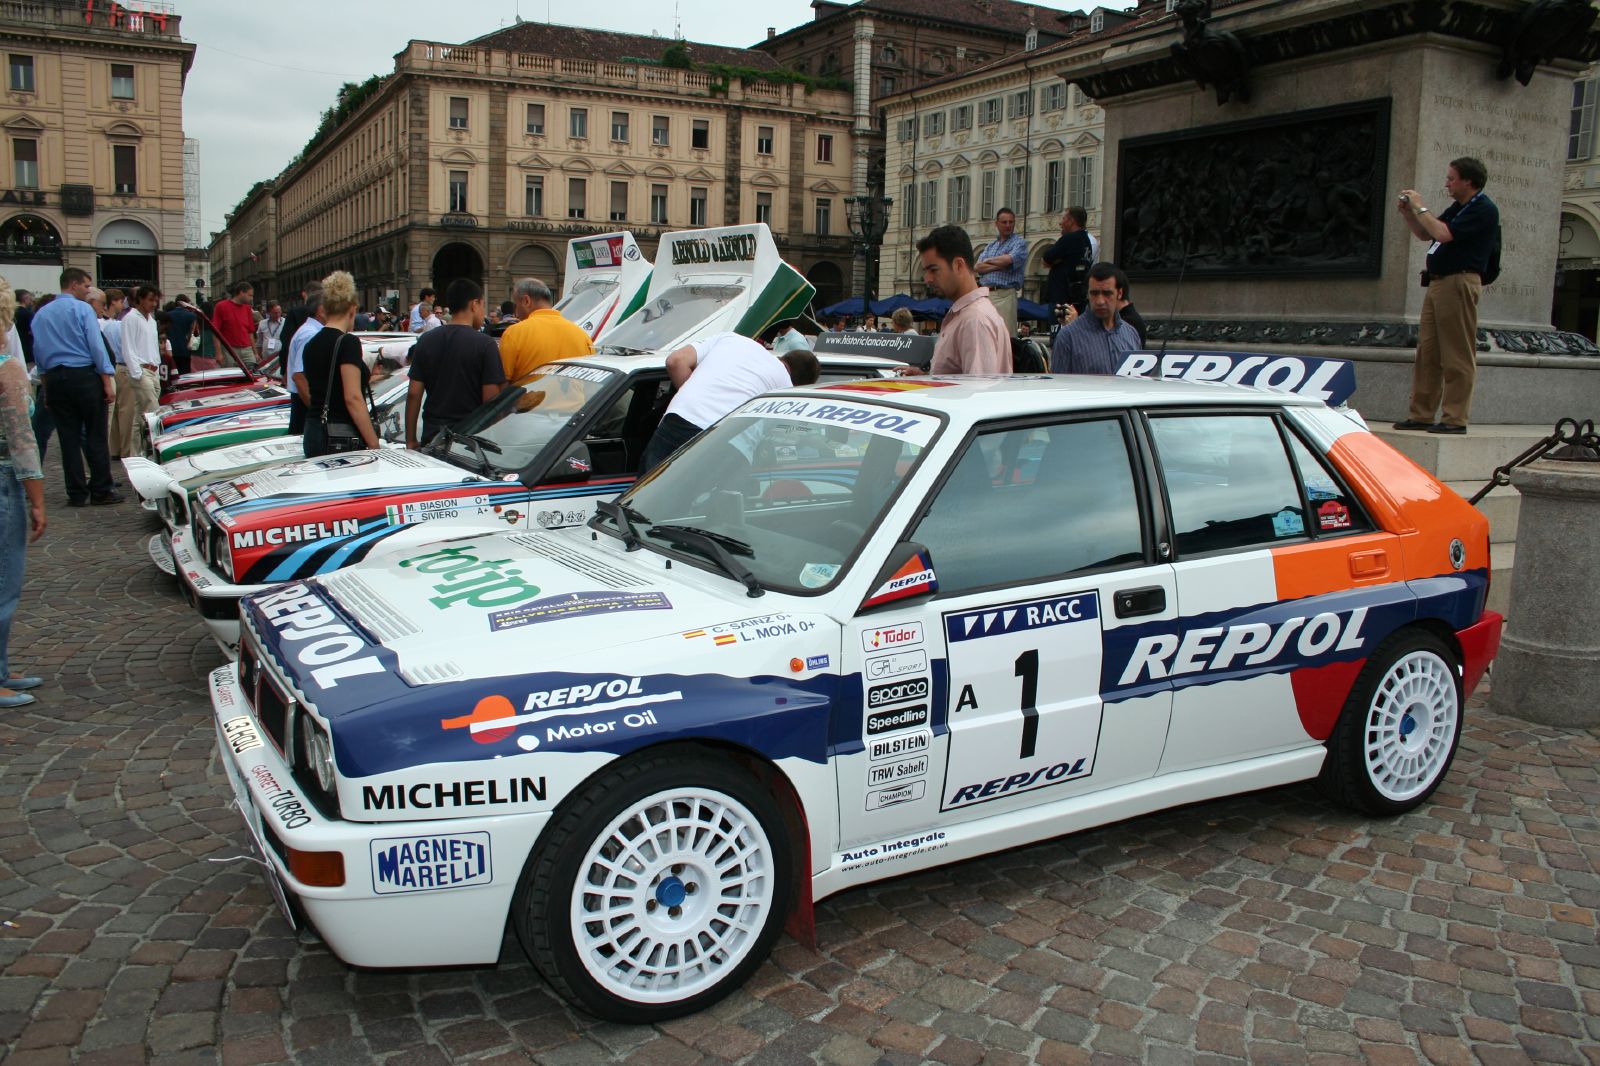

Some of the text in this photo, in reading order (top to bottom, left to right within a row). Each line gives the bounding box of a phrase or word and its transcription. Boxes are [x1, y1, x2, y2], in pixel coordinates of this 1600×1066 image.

[825, 334, 912, 351] www.historiclanciarally.it
[1115, 354, 1347, 400] REPSOL
[740, 400, 921, 433] LANCIA REPSOL
[405, 503, 416, 512] M.
[420, 498, 458, 510] BIASION
[407, 507, 489, 522] T. SIVIERO A+
[233, 518, 360, 549] MICHELIN
[398, 545, 541, 608] totip
[890, 572, 932, 589] REPSOL
[712, 625, 727, 634] C.
[729, 615, 775, 629] SAINZ
[1027, 599, 1082, 626] RACC
[252, 584, 386, 690] REPSOL
[740, 632, 754, 642] L.
[758, 623, 797, 639] MOYA
[883, 629, 916, 644] Tudor
[1117, 606, 1369, 685] REPSOL
[523, 677, 643, 711] REPSOL
[870, 682, 926, 705] sparco
[955, 684, 979, 713] A
[1015, 648, 1039, 759] 1
[546, 710, 658, 742] Motor Oil
[869, 710, 926, 730] Speedline
[874, 735, 926, 757] BILSTEIN
[251, 764, 281, 795] GARRETT
[872, 761, 924, 782] TRW Sabelt
[949, 757, 1087, 805] REPSOL
[362, 776, 547, 810] MICHELIN
[880, 790, 912, 803] CHAMPION
[272, 789, 311, 830] TURBO
[840, 842, 949, 873] www.auto-integrale.co.uk
[841, 831, 945, 862] Auto Integrale
